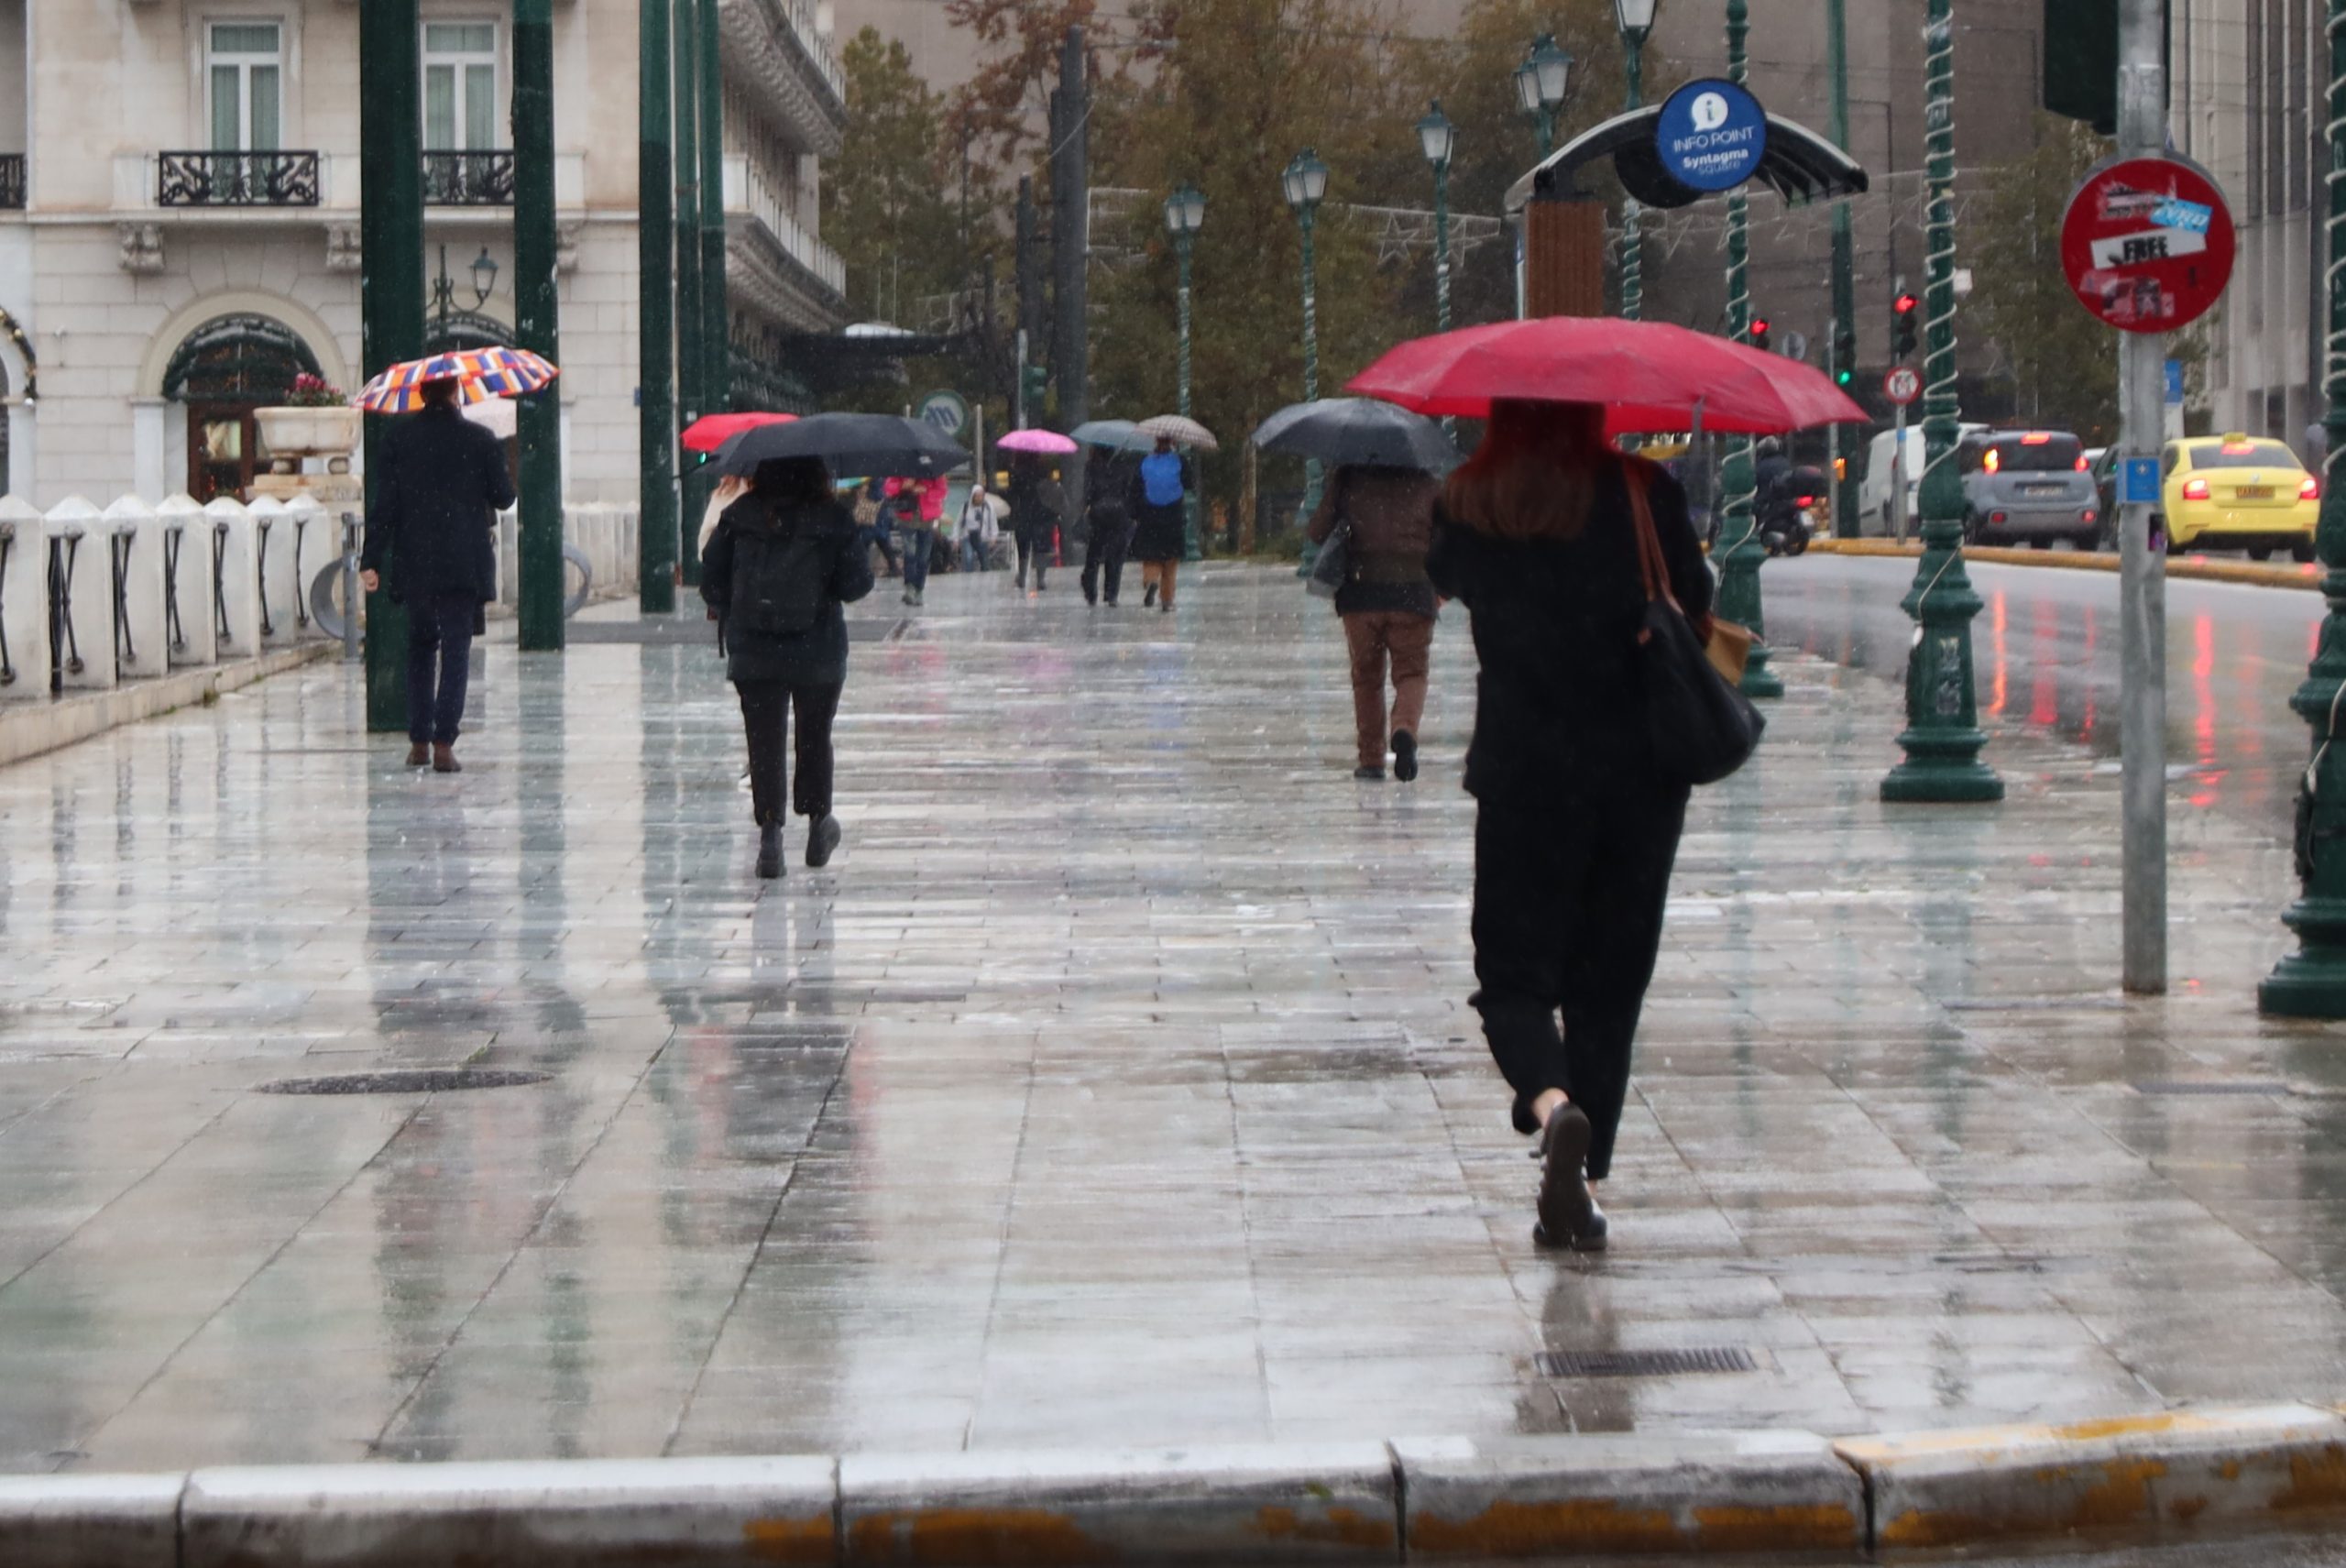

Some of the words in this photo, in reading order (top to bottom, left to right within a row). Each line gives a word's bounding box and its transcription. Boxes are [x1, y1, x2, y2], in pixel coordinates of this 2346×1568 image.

[1705, 99, 1714, 122] i
[1674, 135, 1709, 153] INFO
[1712, 126, 1754, 147] POINT
[1683, 149, 1749, 170] Syntagma
[1698, 162, 1741, 175] square
[2122, 236, 2168, 262] FREE
